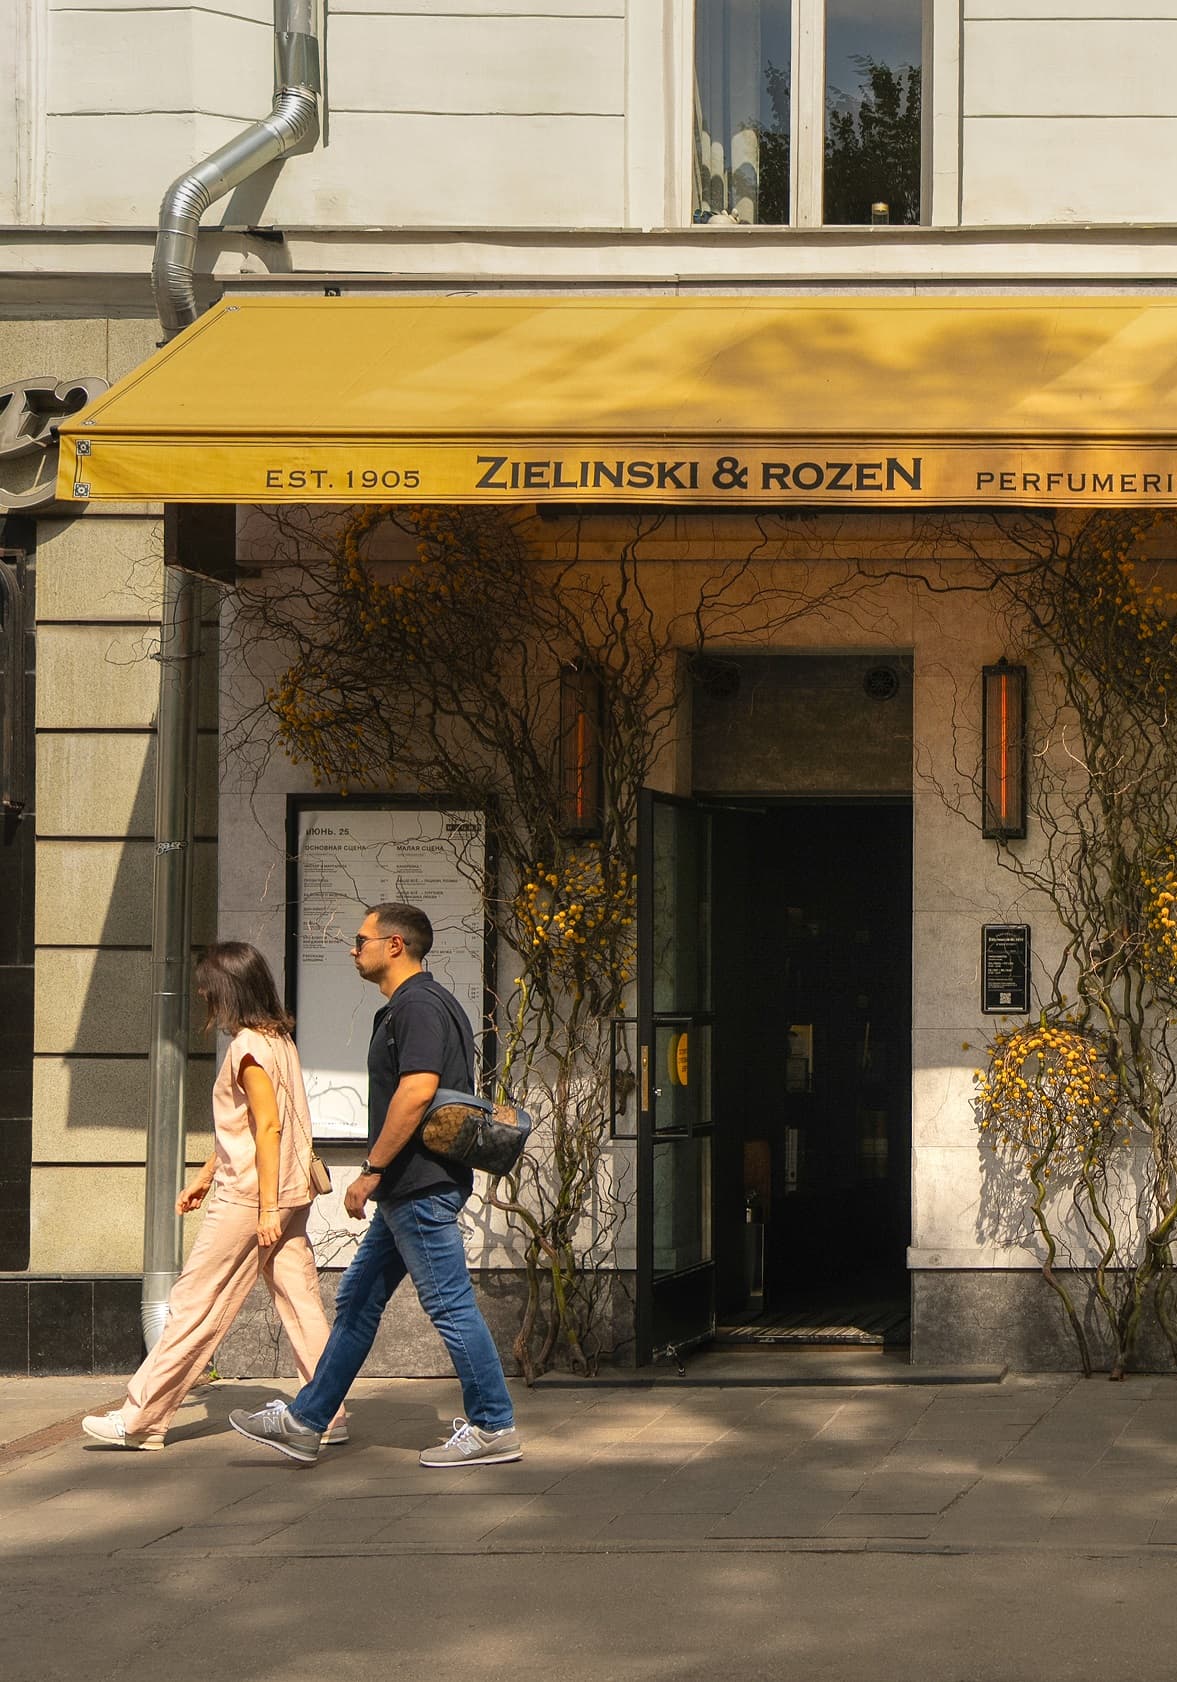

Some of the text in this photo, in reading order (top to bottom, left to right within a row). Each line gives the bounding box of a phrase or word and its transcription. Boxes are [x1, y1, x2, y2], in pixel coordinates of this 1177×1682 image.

[265, 469, 421, 489] EST. 1905
[475, 455, 923, 491] ZIELINSKI & ROZEN
[339, 828, 350, 836] 25
